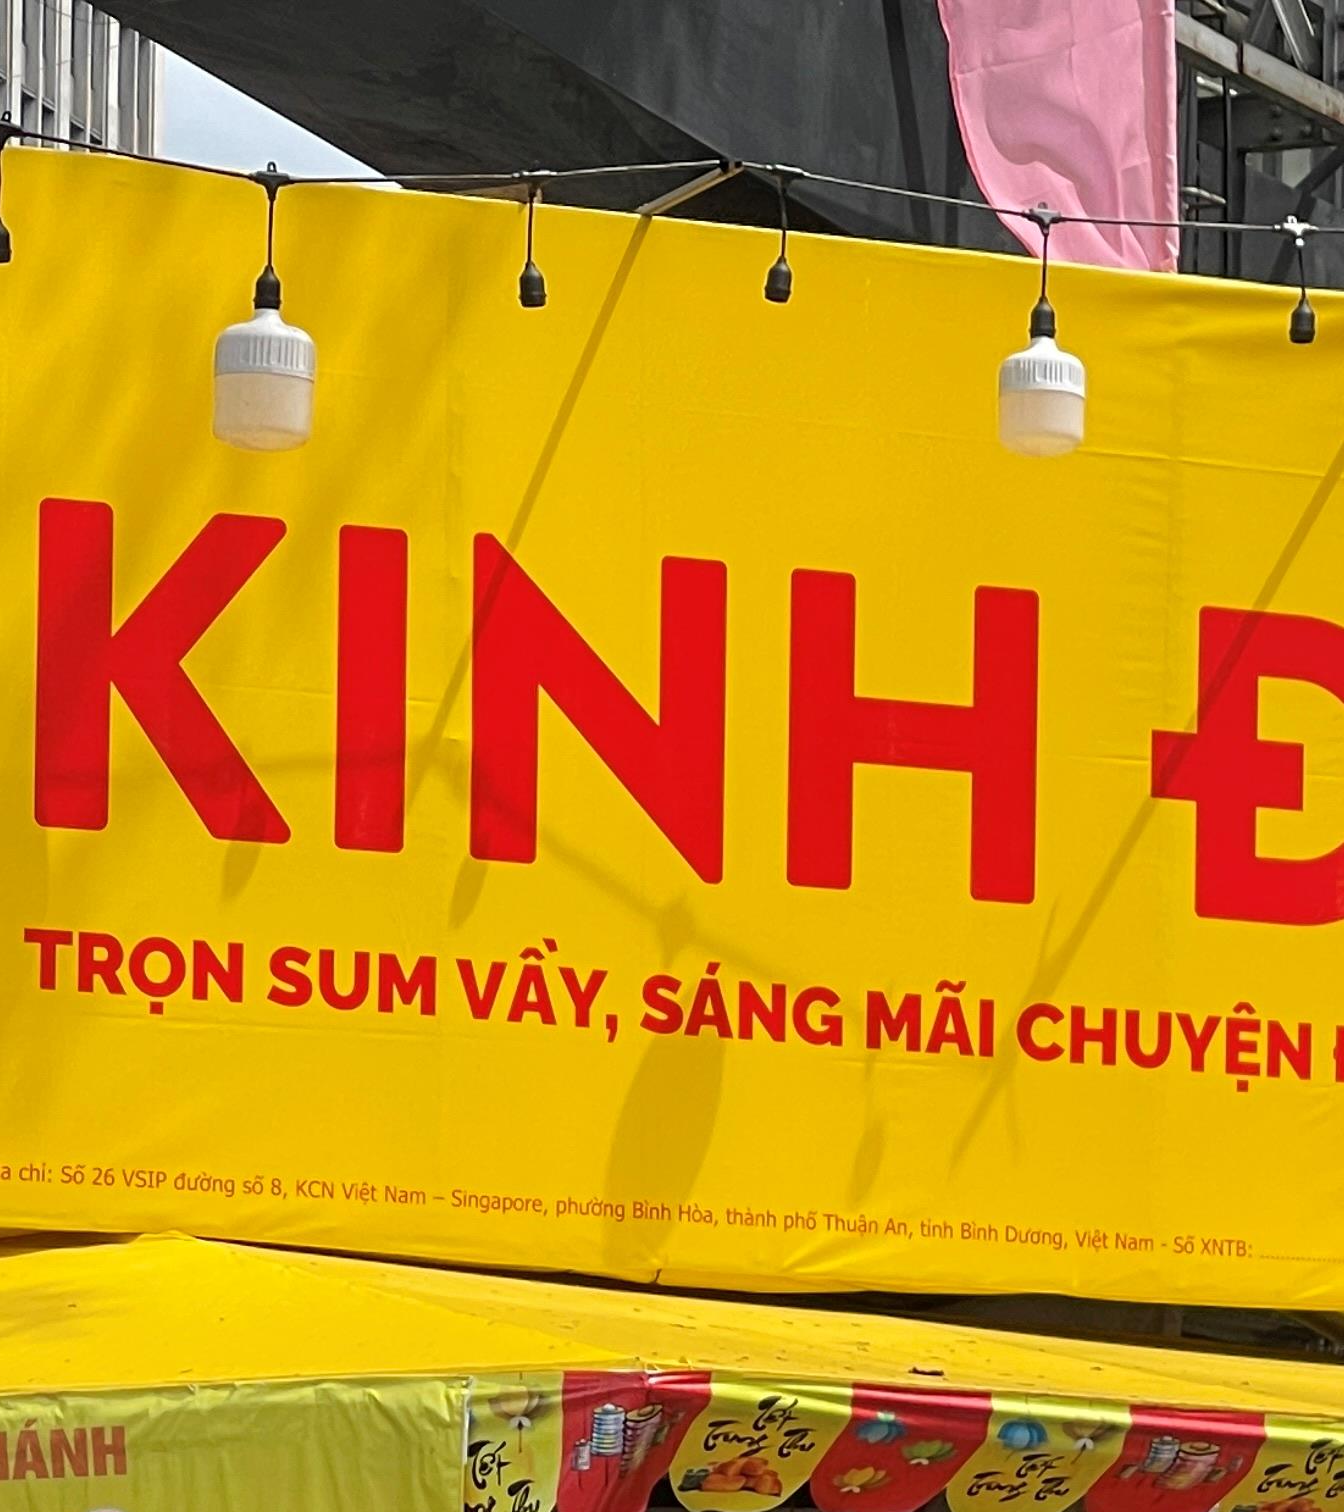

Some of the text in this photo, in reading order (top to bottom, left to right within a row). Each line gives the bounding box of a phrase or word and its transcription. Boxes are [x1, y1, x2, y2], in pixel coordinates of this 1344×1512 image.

[34, 497, 1040, 905] KINH
[23, 928, 244, 1014] TRỌN
[267, 946, 437, 1016] SUM
[457, 937, 618, 1043] VẦY,
[641, 962, 843, 1046] SÁNG
[865, 980, 995, 1057] MÃI
[1016, 1001, 1312, 1093] CHUYỆN
[18, 1161, 54, 1184] chỉ:
[61, 1162, 86, 1185] Số
[91, 1167, 115, 1187] 26
[123, 1169, 167, 1189] VSIP
[174, 1170, 236, 1198] đường
[242, 1172, 265, 1196] số
[271, 1178, 288, 1200] 8,
[296, 1179, 334, 1200] KCN
[343, 1180, 378, 1205] Việt
[384, 1185, 427, 1205] Nam
[451, 1188, 550, 1216] Singapore,
[555, 1192, 626, 1224] phường
[632, 1199, 672, 1221] Bình
[678, 1203, 719, 1228] Hòa,
[726, 1205, 777, 1229] thành
[783, 1207, 817, 1235] phố
[823, 1212, 878, 1238] Thuận
[884, 1218, 915, 1241] An,
[920, 1217, 954, 1240] tỉnh
[960, 1219, 999, 1244] Bình
[1005, 1224, 1069, 1252] Dương,
[1075, 1227, 1108, 1253] Việt
[1115, 1231, 1155, 1253] Nam
[1173, 1232, 1195, 1256] Số
[1201, 1236, 1253, 1260] XNTB:
